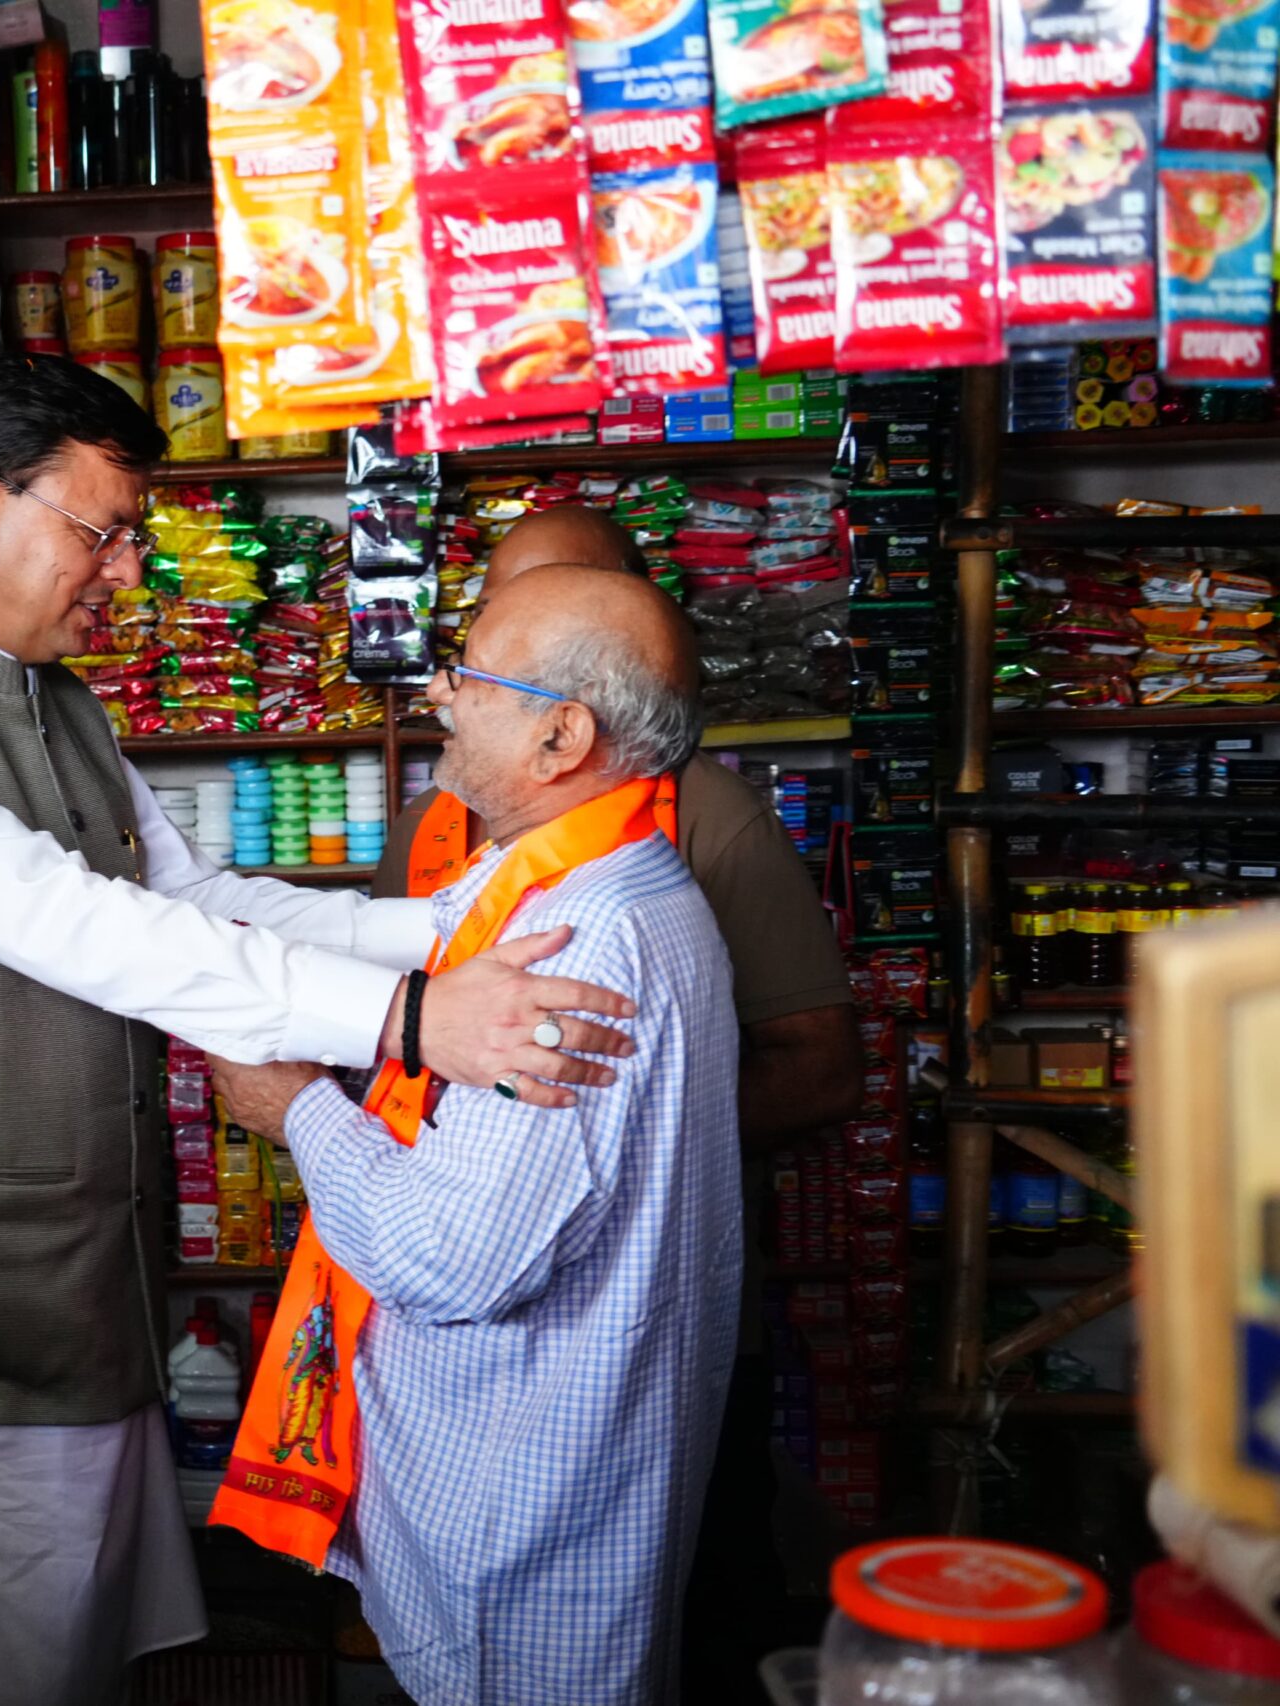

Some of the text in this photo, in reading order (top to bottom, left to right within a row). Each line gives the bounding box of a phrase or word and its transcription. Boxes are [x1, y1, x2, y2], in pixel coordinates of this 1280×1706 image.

[887, 64, 956, 104] Suha
[592, 114, 702, 154] Suhana
[448, 214, 565, 259] Suhana
[1019, 272, 1135, 310] Suhana
[777, 310, 837, 344] hana
[856, 293, 962, 330] Suhana
[612, 341, 714, 378] Suhana
[1180, 331, 1264, 365] Suhana
[1007, 771, 1042, 781] COLOR
[1010, 780, 1039, 788] MATE
